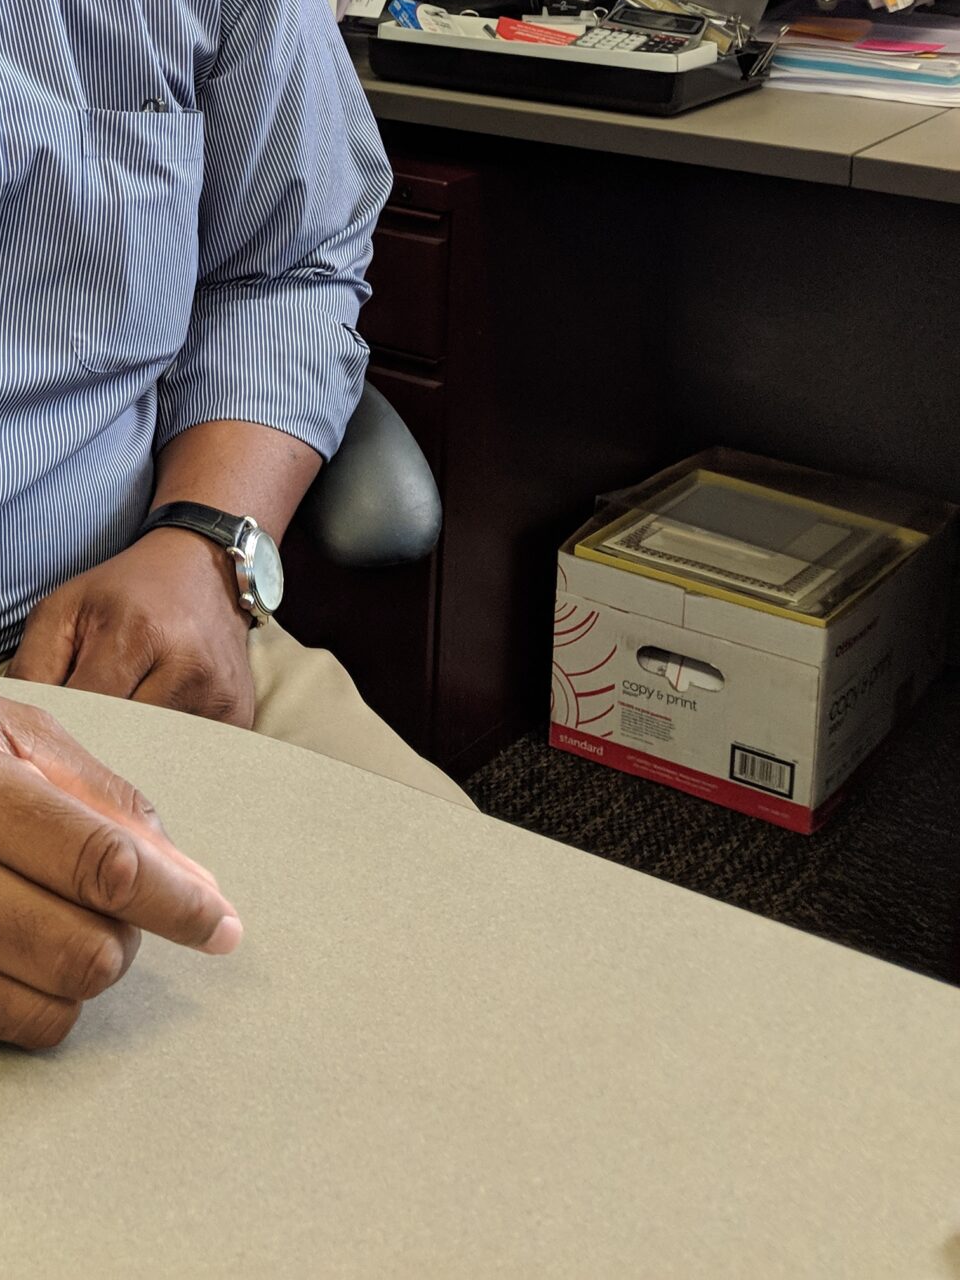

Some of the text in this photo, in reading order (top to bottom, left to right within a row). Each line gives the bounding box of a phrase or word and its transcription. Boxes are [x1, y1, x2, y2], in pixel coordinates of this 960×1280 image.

[622, 679, 656, 700] copy
[656, 689, 665, 700] &
[666, 693, 698, 712] print
[559, 733, 604, 757] standard
